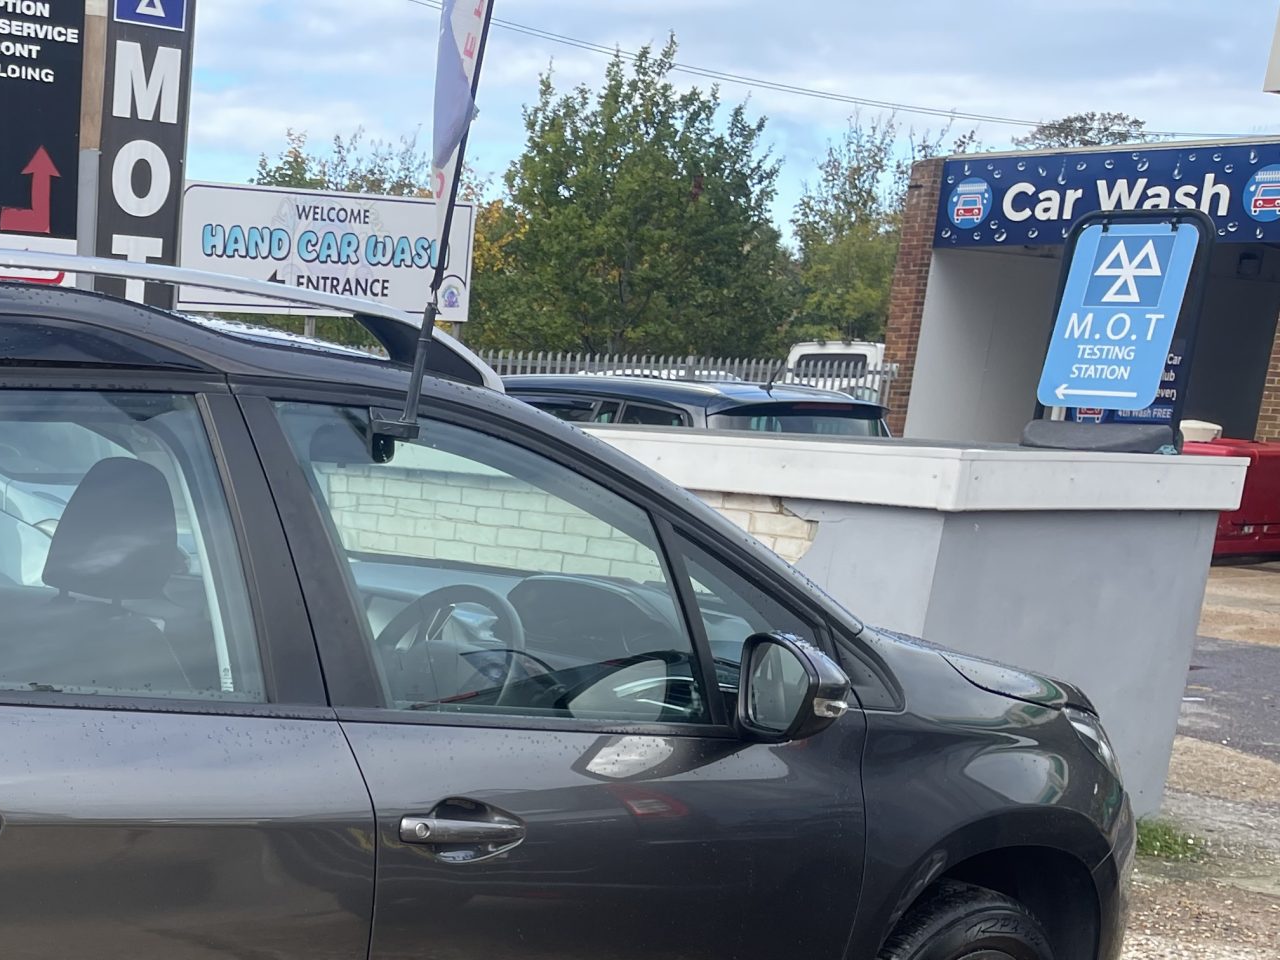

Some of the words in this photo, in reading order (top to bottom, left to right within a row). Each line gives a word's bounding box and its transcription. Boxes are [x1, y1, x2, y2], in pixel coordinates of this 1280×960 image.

[1002, 181, 1083, 222] Car
[1096, 173, 1231, 216] Wash
[295, 205, 370, 225] WELCOME
[202, 223, 292, 261] HAND
[296, 230, 360, 265] CAR
[296, 274, 389, 298] ENTRANCE
[1077, 344, 1136, 361] TESTING
[1070, 363, 1131, 380] STATION
